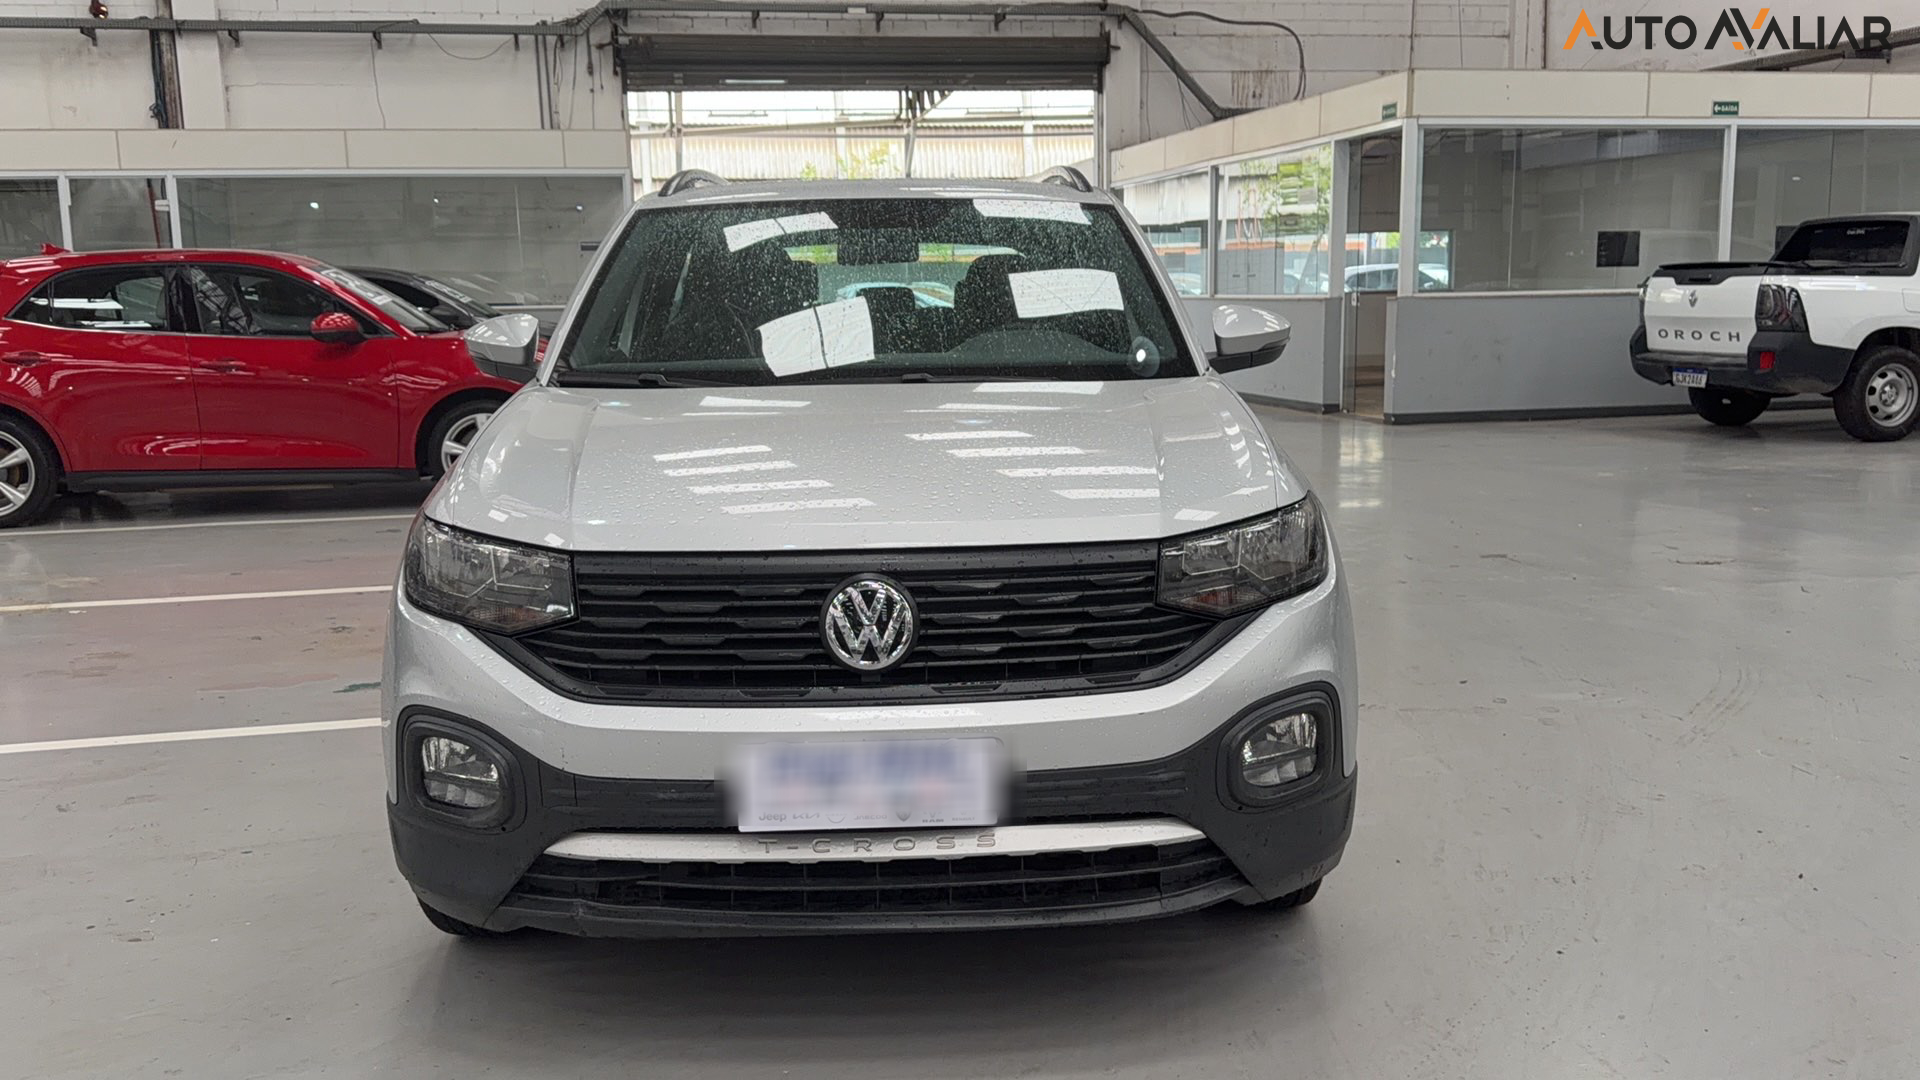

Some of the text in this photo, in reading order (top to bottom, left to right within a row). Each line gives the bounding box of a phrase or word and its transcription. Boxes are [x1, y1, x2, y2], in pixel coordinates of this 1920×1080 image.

[1658, 328, 1740, 342] OROCH
[759, 812, 787, 822] Jeep
[758, 833, 996, 854] T-CROSS
